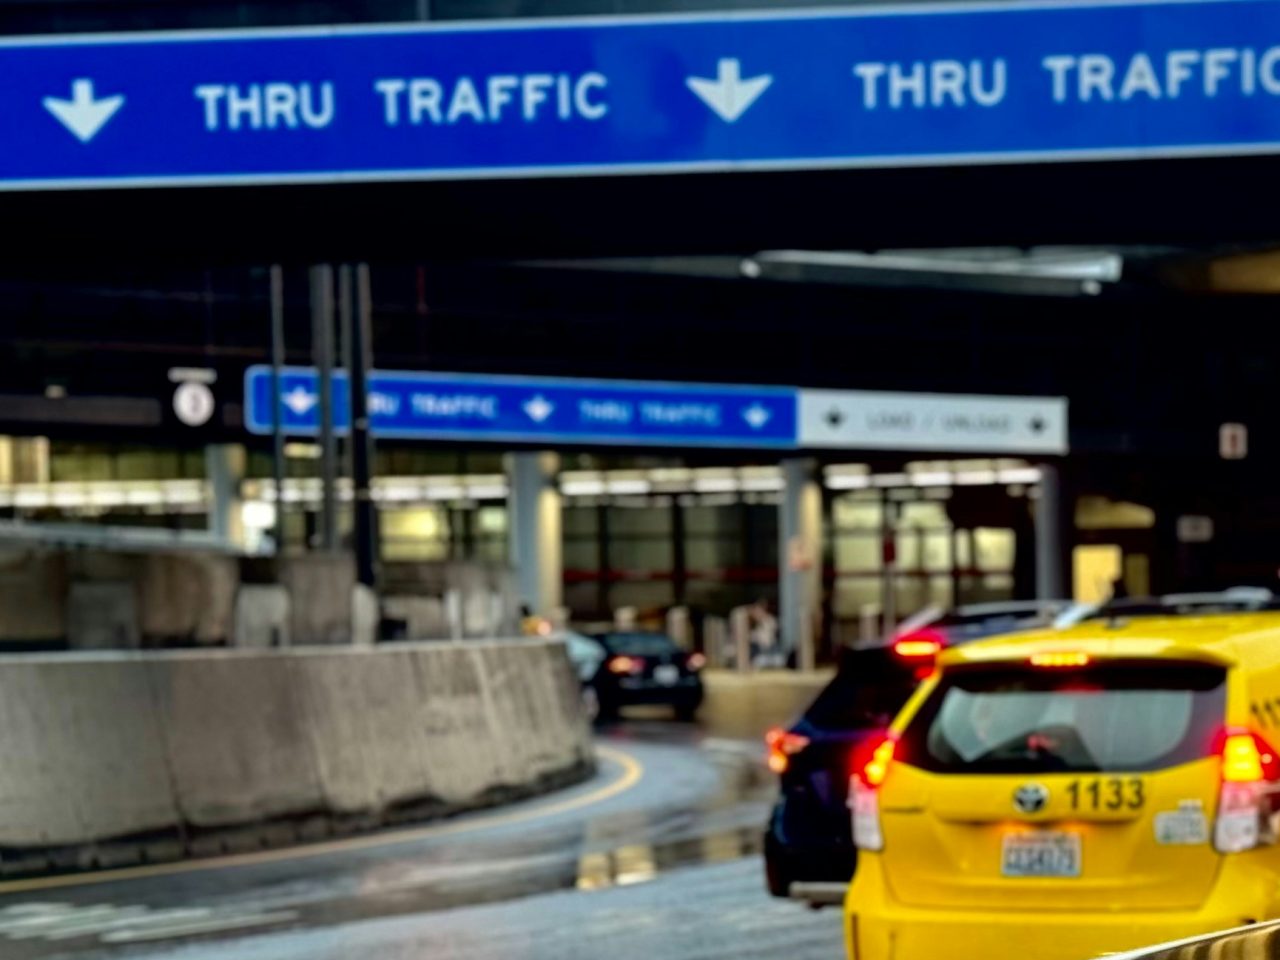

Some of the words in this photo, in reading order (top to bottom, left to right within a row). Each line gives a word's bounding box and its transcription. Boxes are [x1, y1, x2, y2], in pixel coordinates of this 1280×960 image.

[196, 83, 334, 128] THRU
[376, 73, 607, 124] TRAFFIC
[854, 60, 1006, 108] THRU
[1065, 779, 1147, 811] 1133
